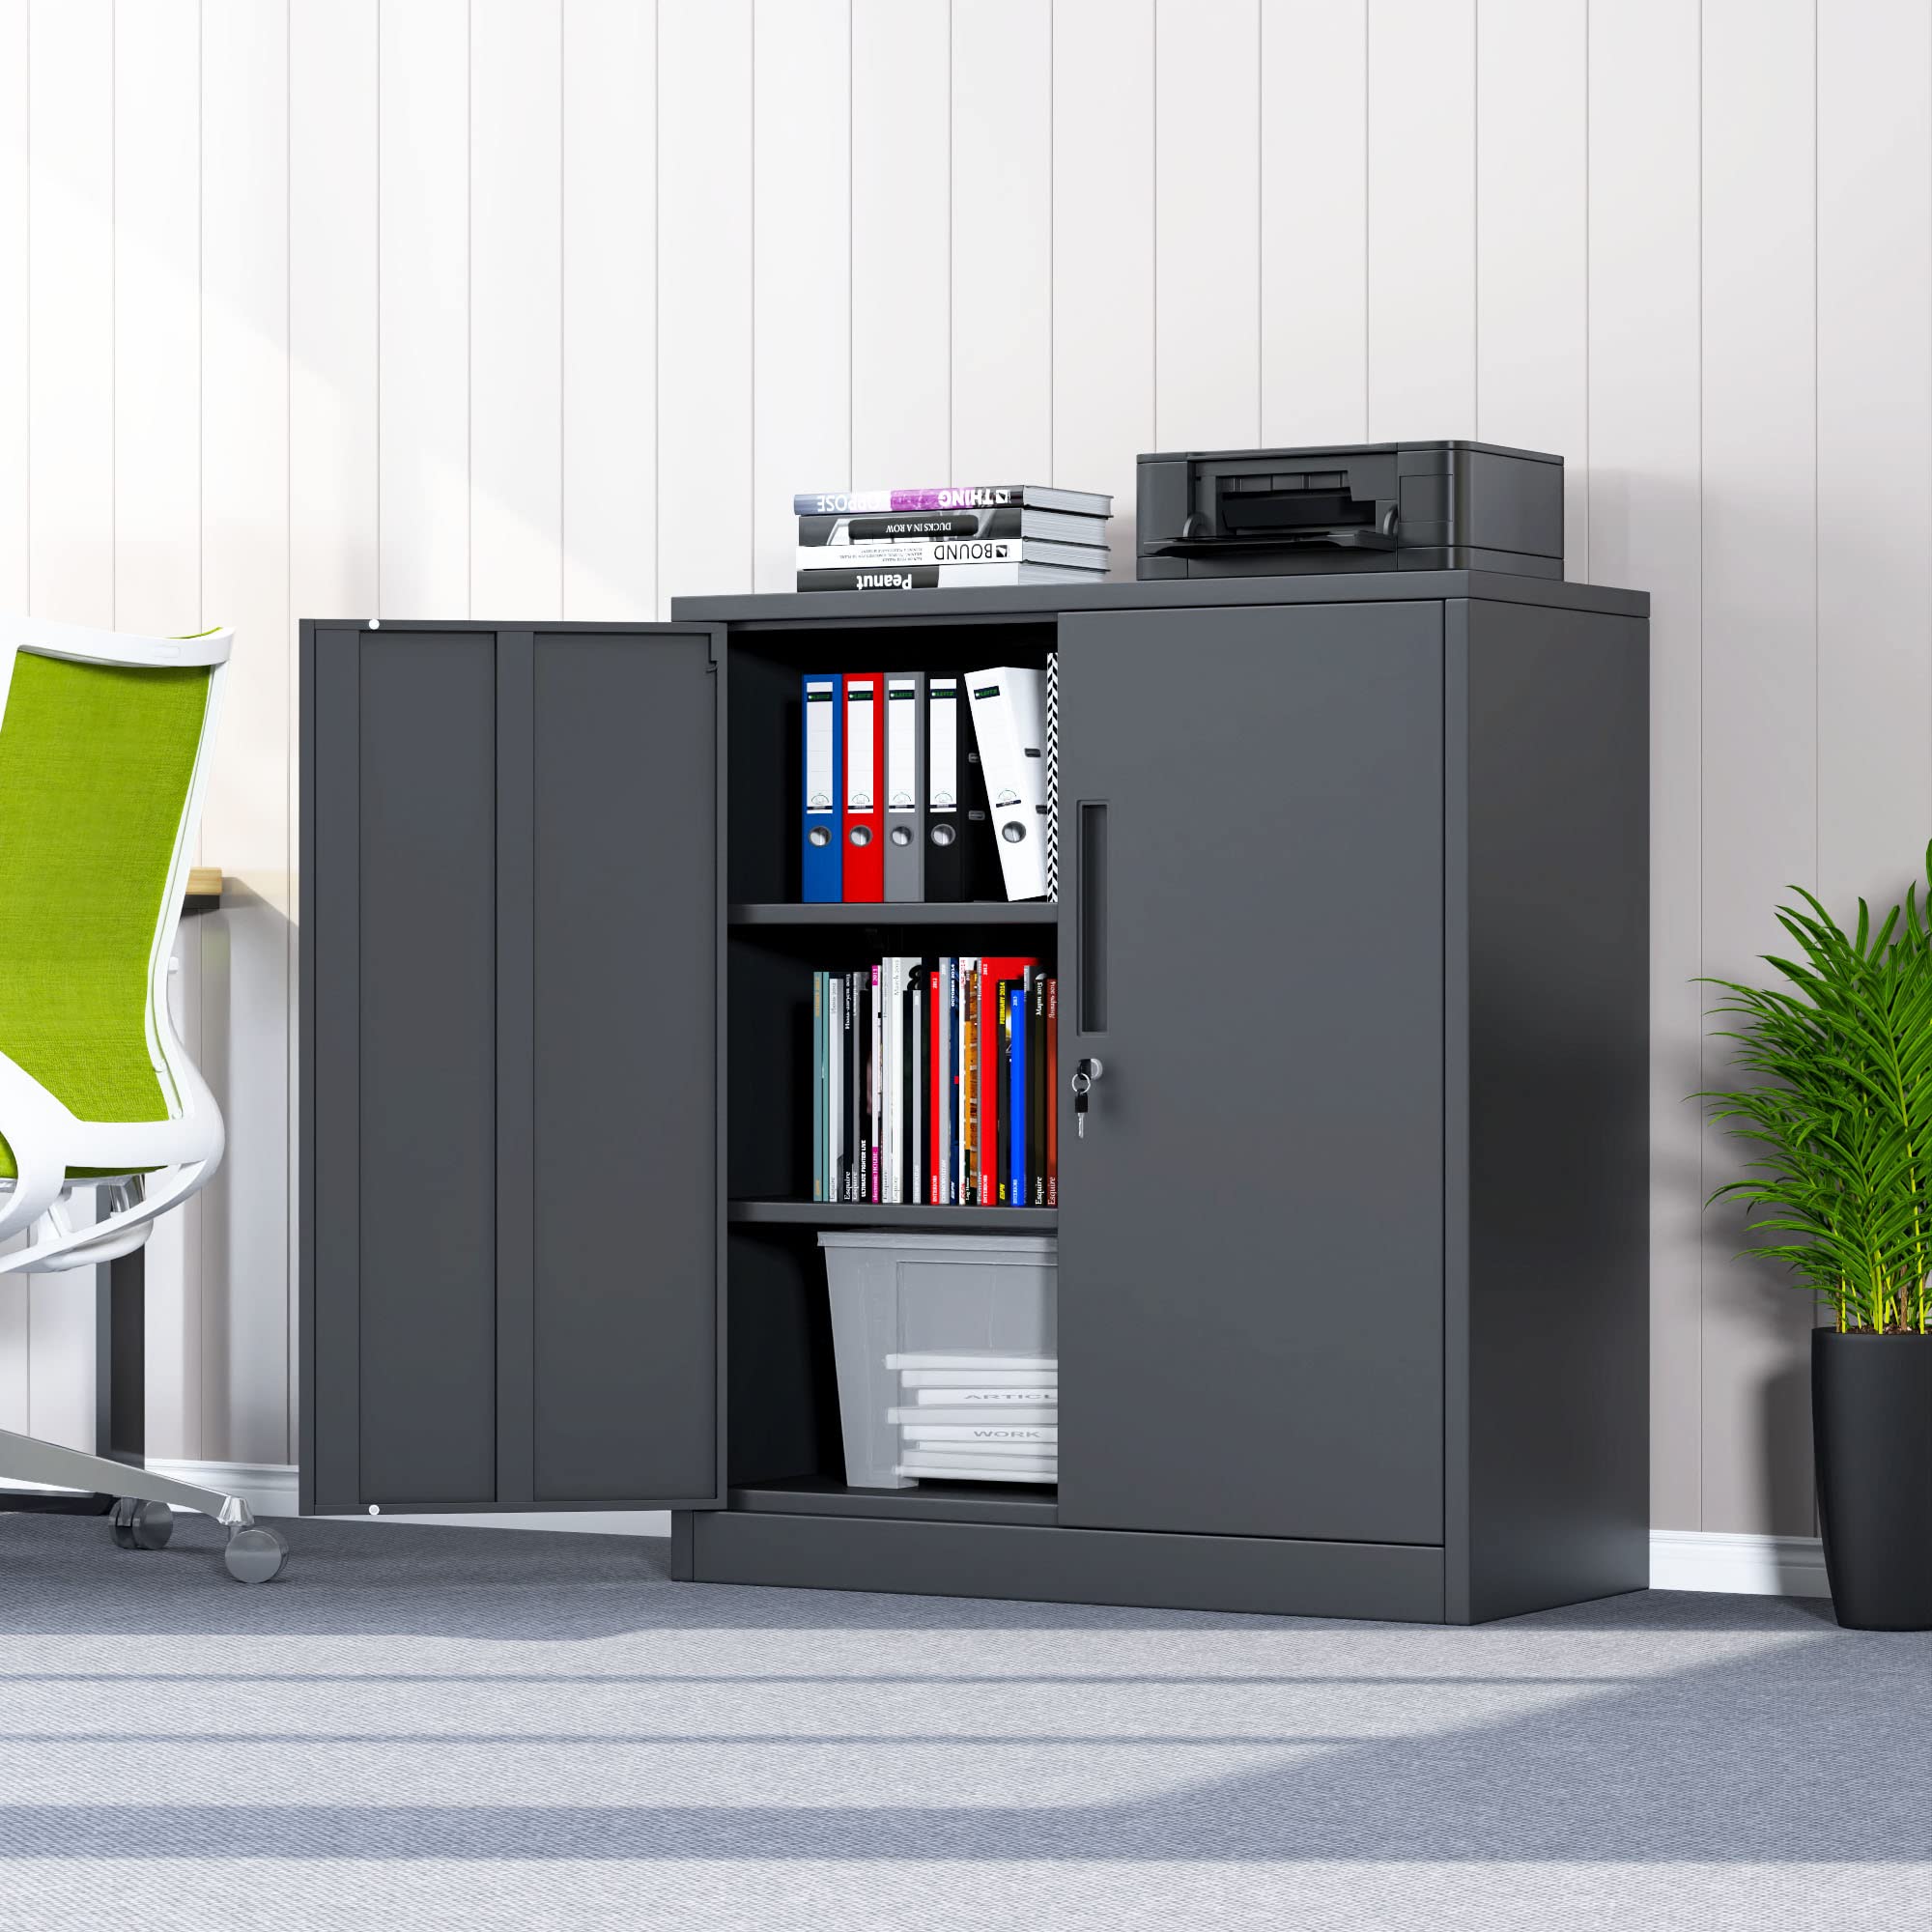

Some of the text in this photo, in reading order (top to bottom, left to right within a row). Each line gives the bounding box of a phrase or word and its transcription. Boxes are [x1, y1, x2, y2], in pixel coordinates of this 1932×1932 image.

[938, 489, 993, 507] THING
[885, 524, 905, 533] ROW
[913, 523, 923, 531] IN
[924, 522, 952, 531] DUCKS
[933, 543, 992, 560] BOUND
[856, 574, 912, 590] Peanut
[1036, 1177, 1044, 1205] Esquire
[1047, 1177, 1056, 1205] Esquire
